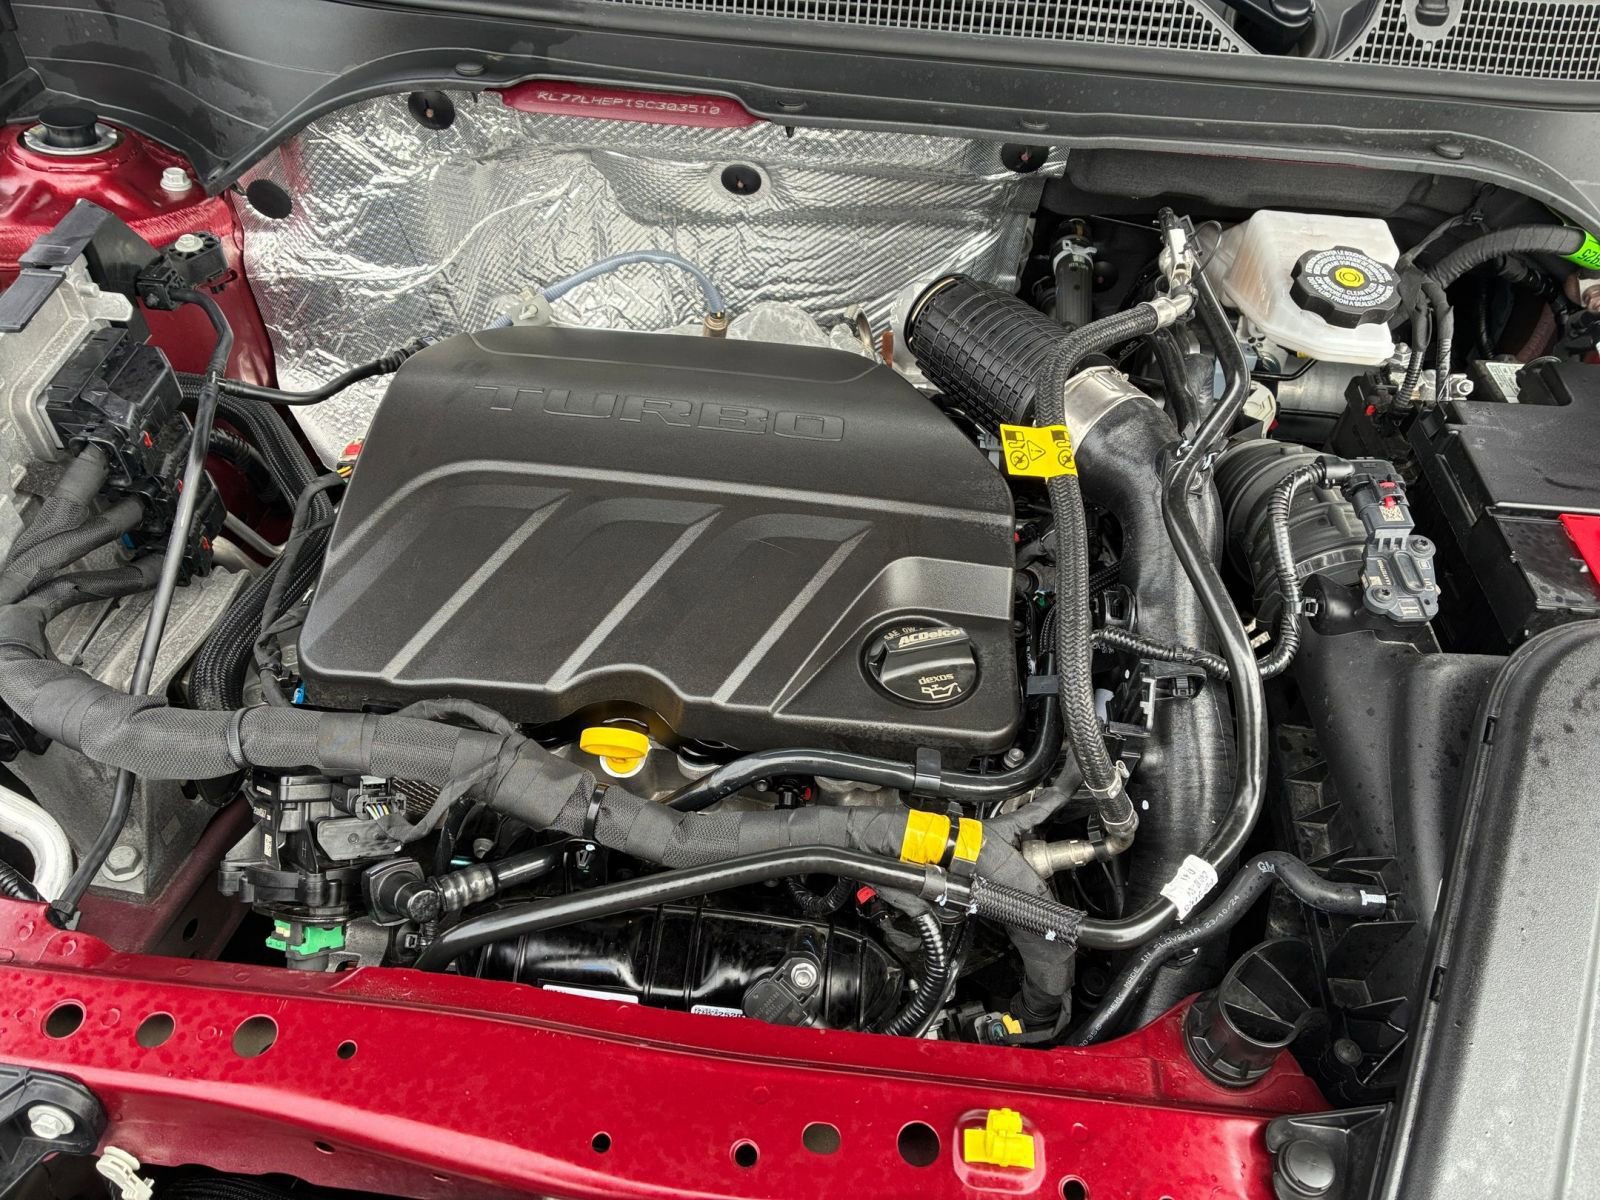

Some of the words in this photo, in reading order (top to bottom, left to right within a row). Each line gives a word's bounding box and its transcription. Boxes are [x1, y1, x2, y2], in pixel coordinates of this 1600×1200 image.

[473, 384, 845, 442] TURBO
[884, 629, 900, 641] SAE
[898, 629, 961, 648] ACDelco
[918, 673, 955, 685] dexos
